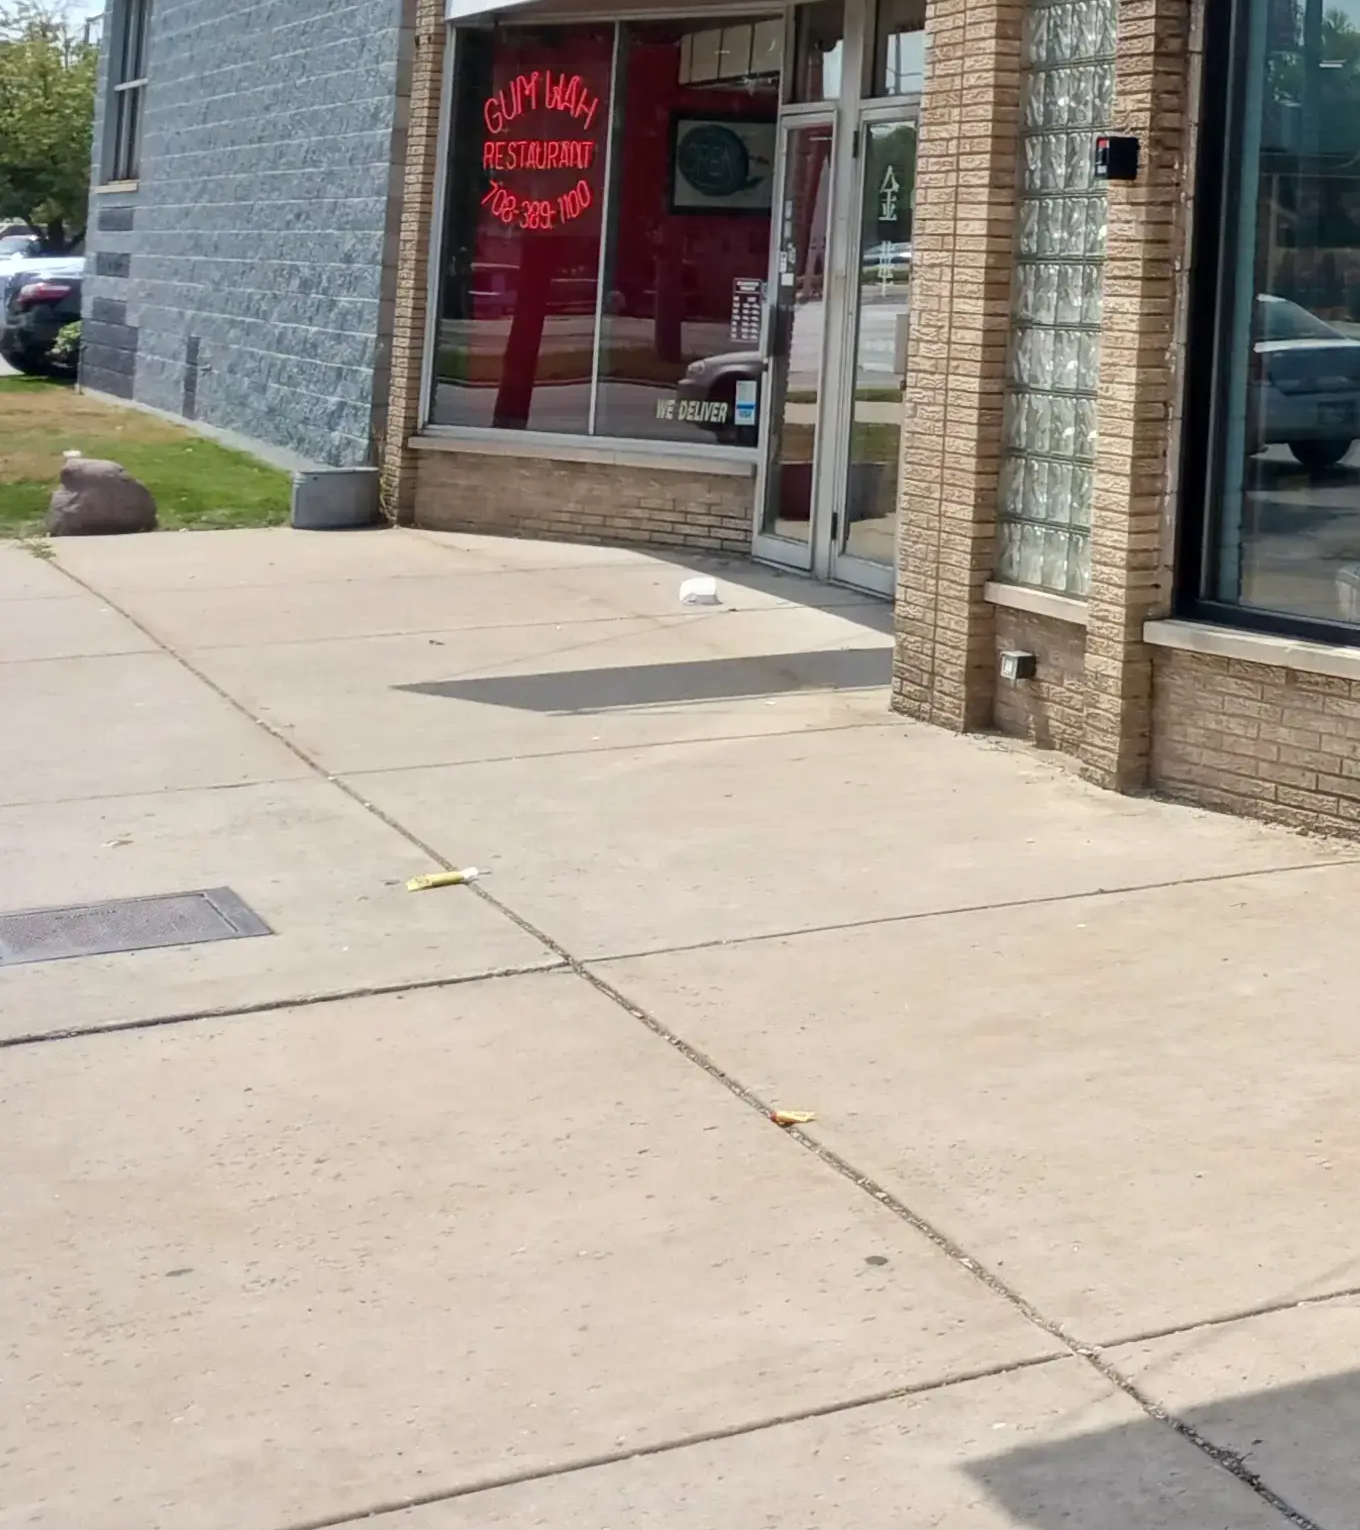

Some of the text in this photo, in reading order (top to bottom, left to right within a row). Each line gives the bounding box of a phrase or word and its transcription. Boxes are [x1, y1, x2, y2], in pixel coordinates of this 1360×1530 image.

[484, 69, 599, 134] GUM WAH
[483, 141, 595, 170] RESTAURANT
[480, 179, 592, 230] 708-389-1100
[656, 398, 677, 420] WE
[678, 399, 728, 423] DELIVER
